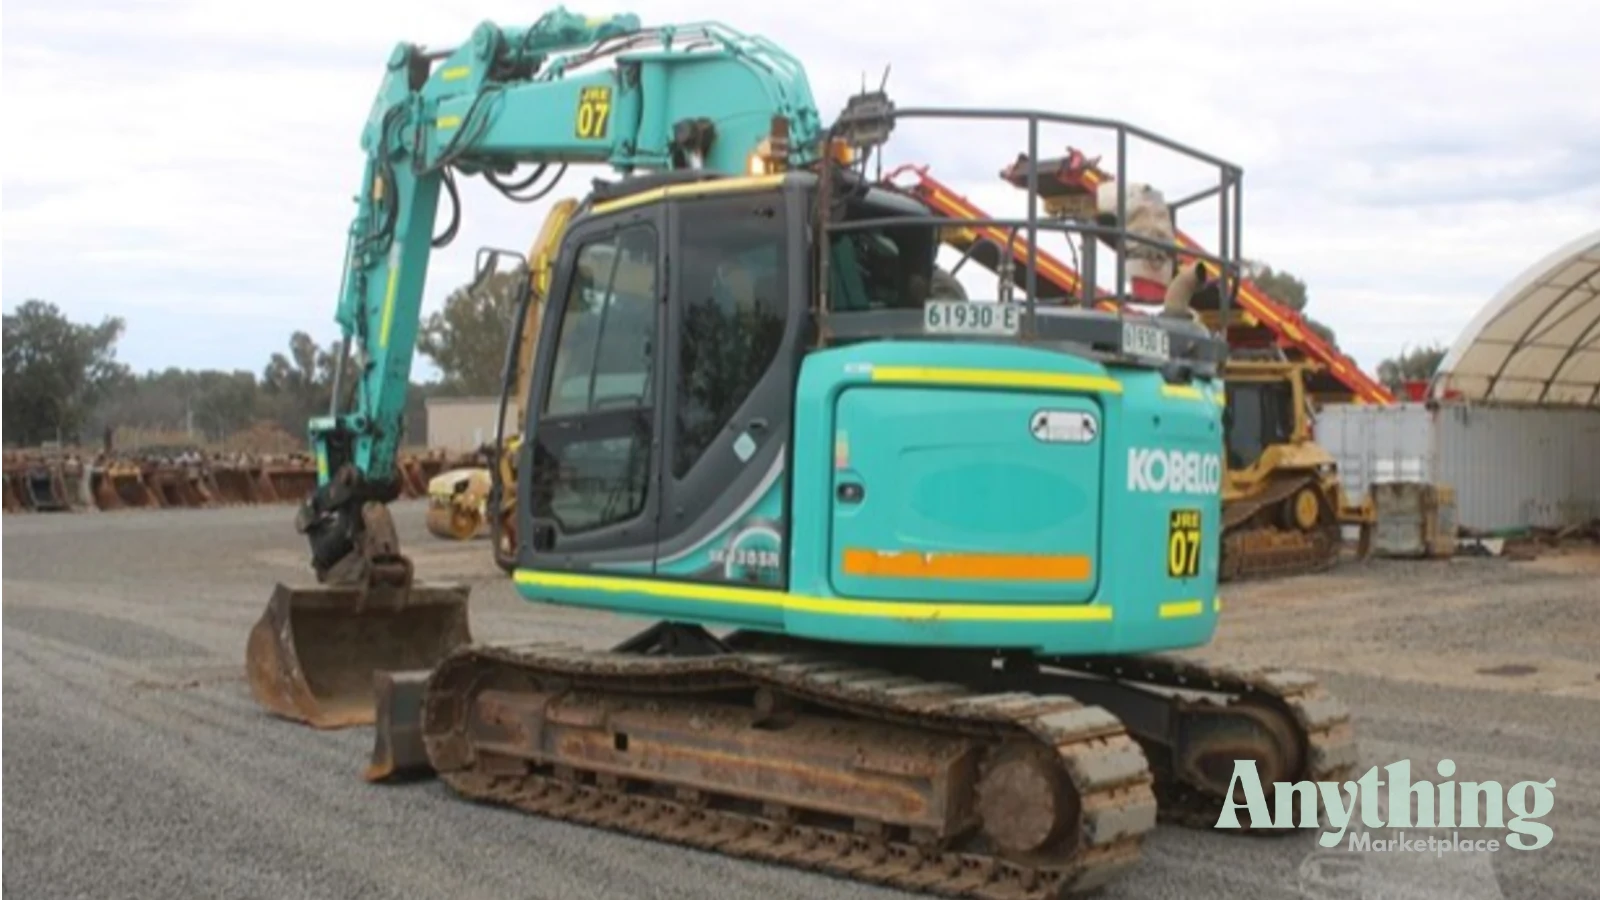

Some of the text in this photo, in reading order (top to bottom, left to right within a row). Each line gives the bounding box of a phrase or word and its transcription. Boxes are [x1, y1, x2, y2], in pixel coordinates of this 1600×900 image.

[578, 102, 608, 137] 07
[928, 303, 1016, 329] 61930 E
[1127, 447, 1220, 494] KOBELCO
[1171, 530, 1200, 575] 07
